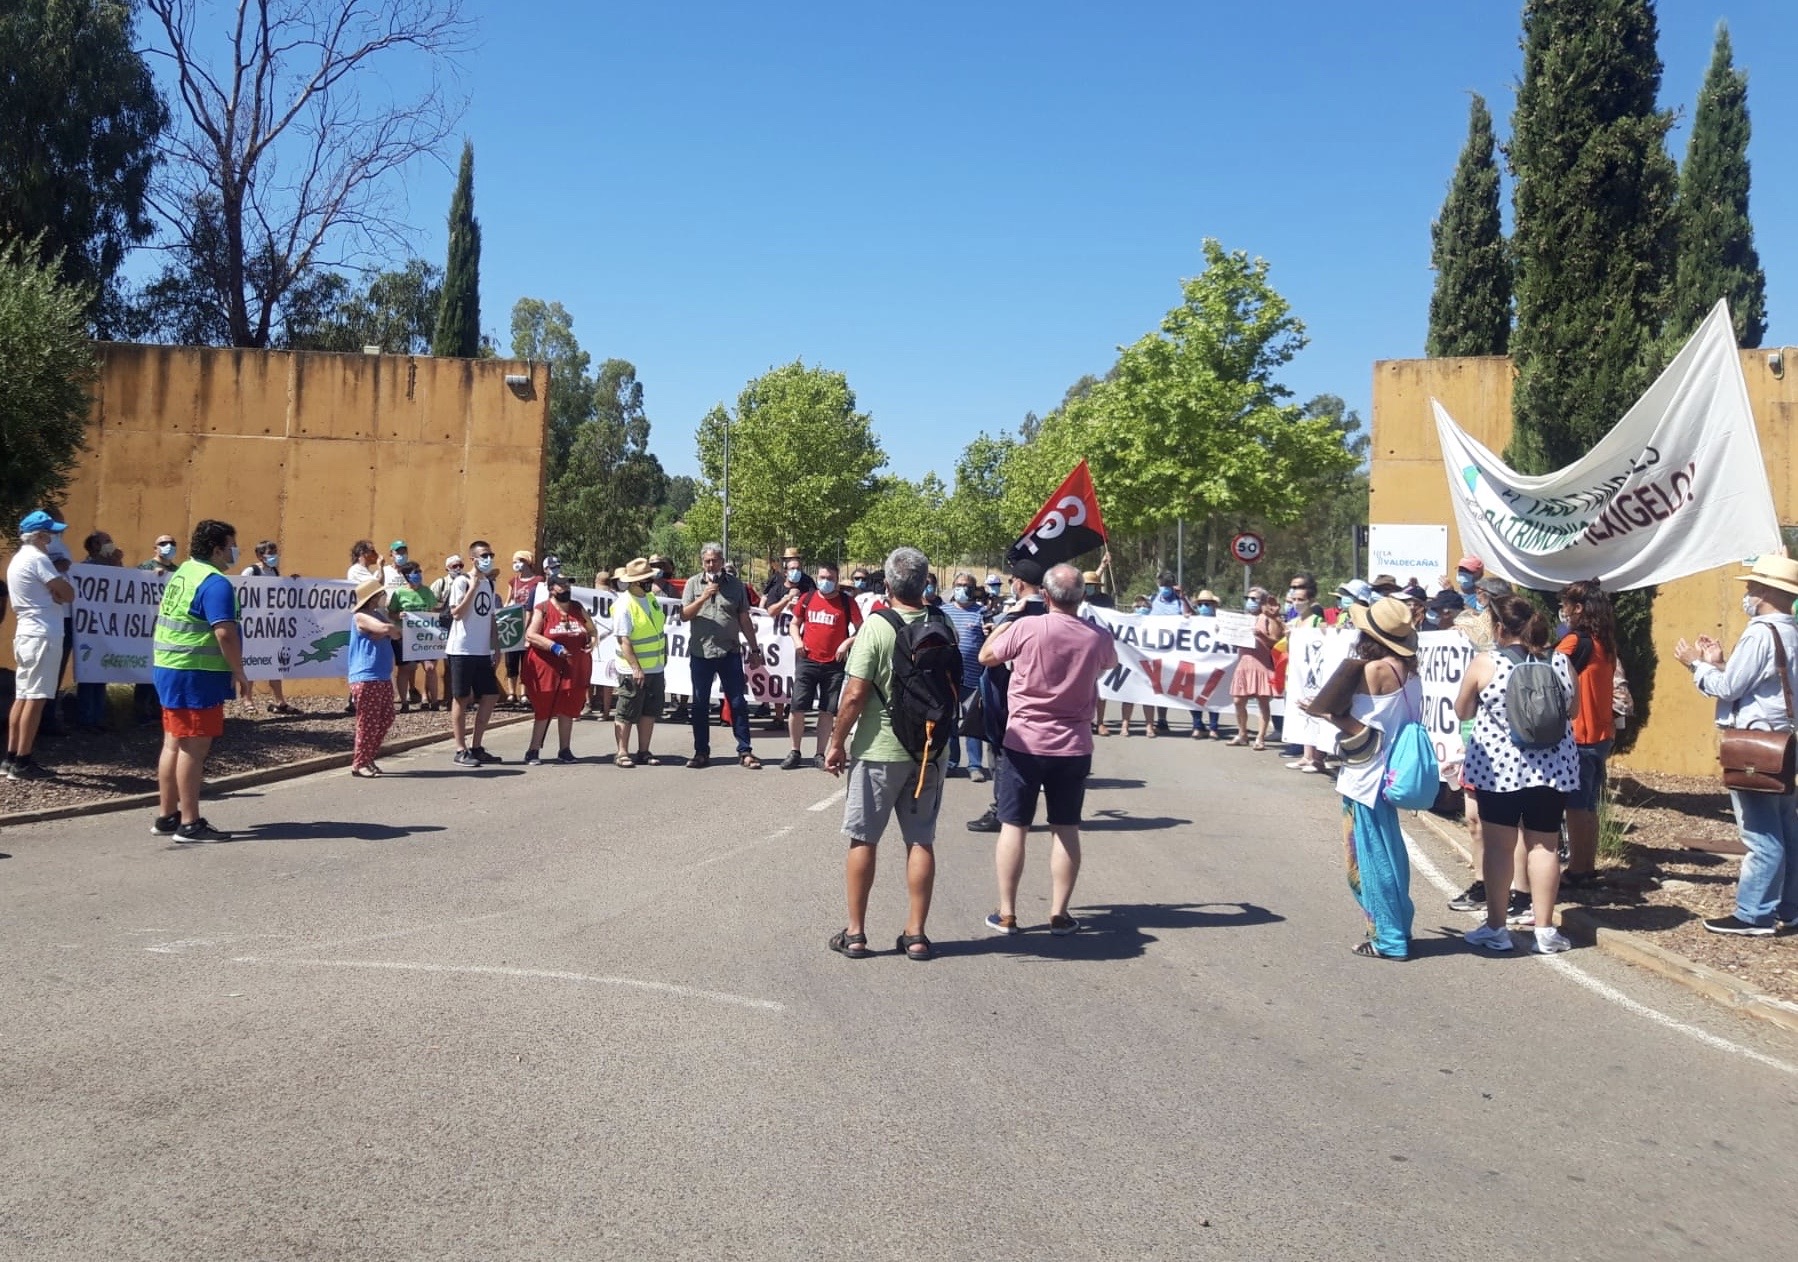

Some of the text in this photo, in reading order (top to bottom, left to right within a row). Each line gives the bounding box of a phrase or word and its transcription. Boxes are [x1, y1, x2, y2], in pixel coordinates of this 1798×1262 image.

[1239, 542, 1256, 553] 50
[1384, 558, 1439, 567] VALDECAÑAS
[115, 579, 135, 604] LA
[267, 584, 358, 609] ECOLÓGICA
[76, 608, 98, 634] DE
[243, 612, 297, 638] CAÑAS
[416, 632, 433, 641] en
[1139, 658, 1226, 707] YA!
